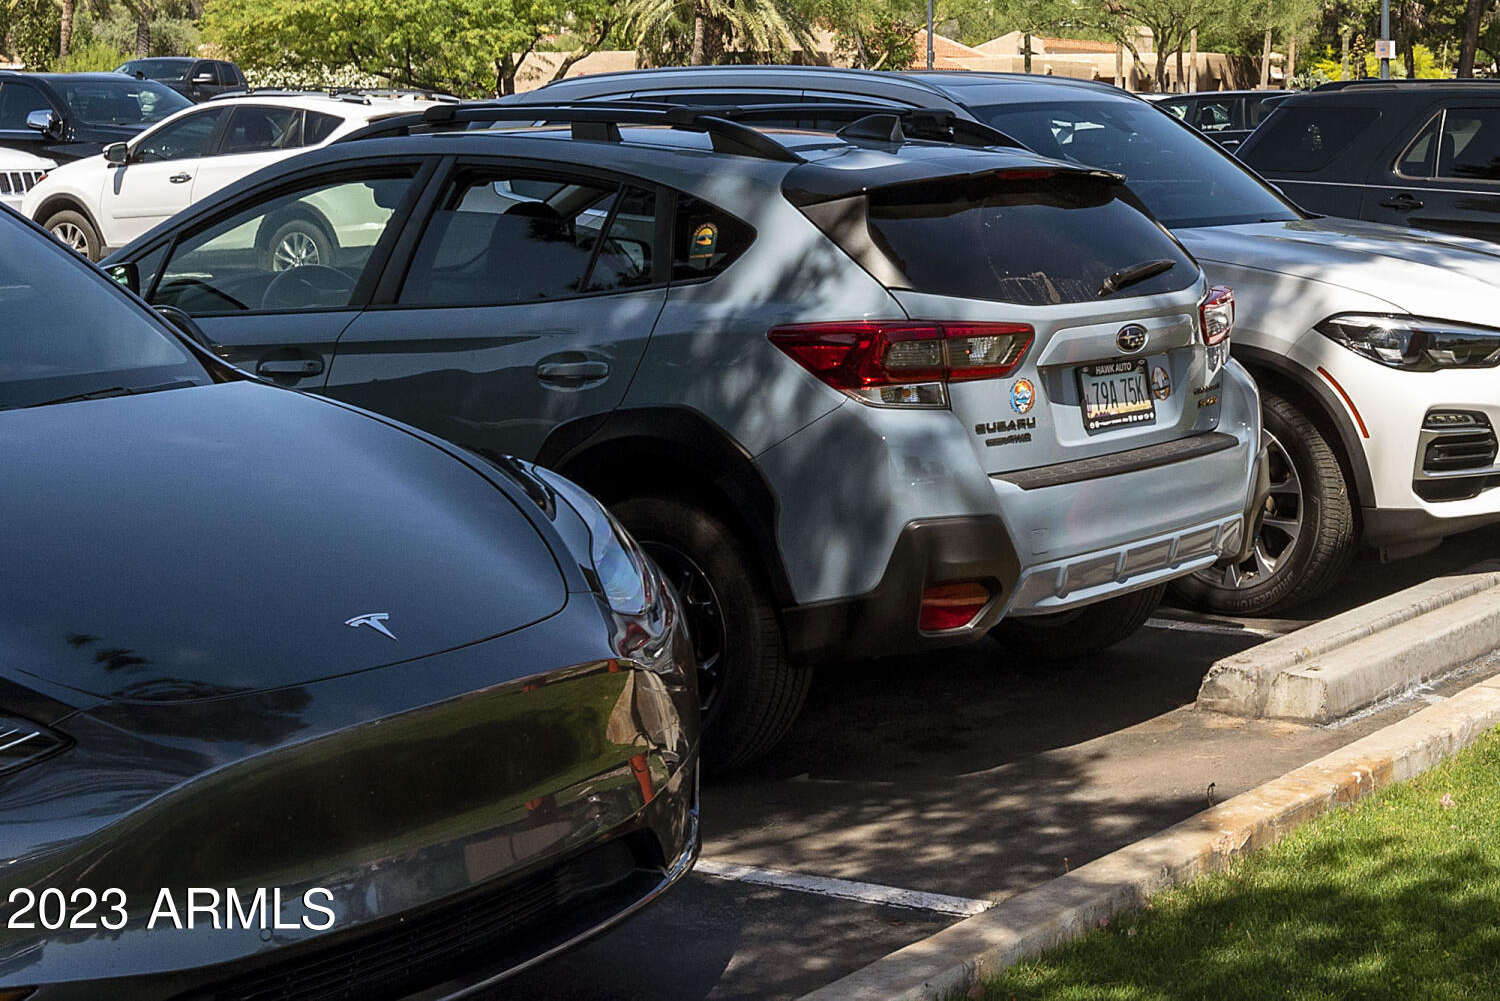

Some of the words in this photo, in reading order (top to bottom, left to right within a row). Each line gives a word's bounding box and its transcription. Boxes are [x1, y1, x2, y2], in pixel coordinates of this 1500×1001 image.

[1095, 364, 1115, 375] HAWK
[1115, 362, 1132, 372] AUTO
[975, 416, 1036, 435] SUBARU
